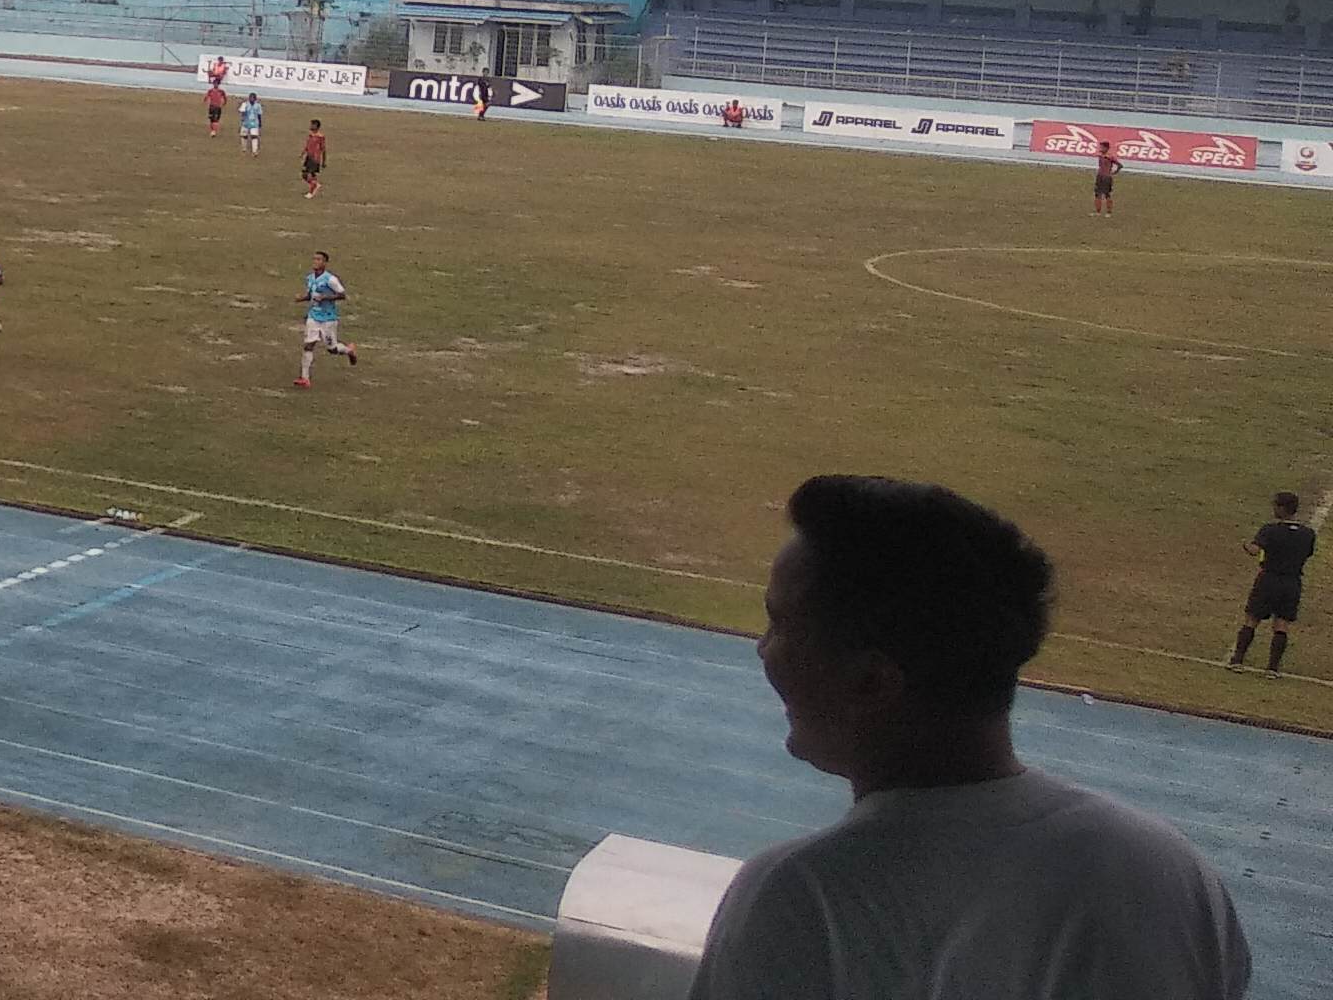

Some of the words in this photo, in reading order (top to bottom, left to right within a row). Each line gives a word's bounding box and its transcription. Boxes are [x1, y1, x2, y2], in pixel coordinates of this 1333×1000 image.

[234, 62, 264, 78] J&F
[265, 65, 296, 81] J&F
[297, 68, 329, 83] J&F
[835, 115, 902, 130] APPAREL
[935, 123, 1005, 138] APPAREL
[1045, 138, 1098, 154] SPECS
[1116, 144, 1170, 161] SPECS
[1190, 150, 1246, 167] SPECS
